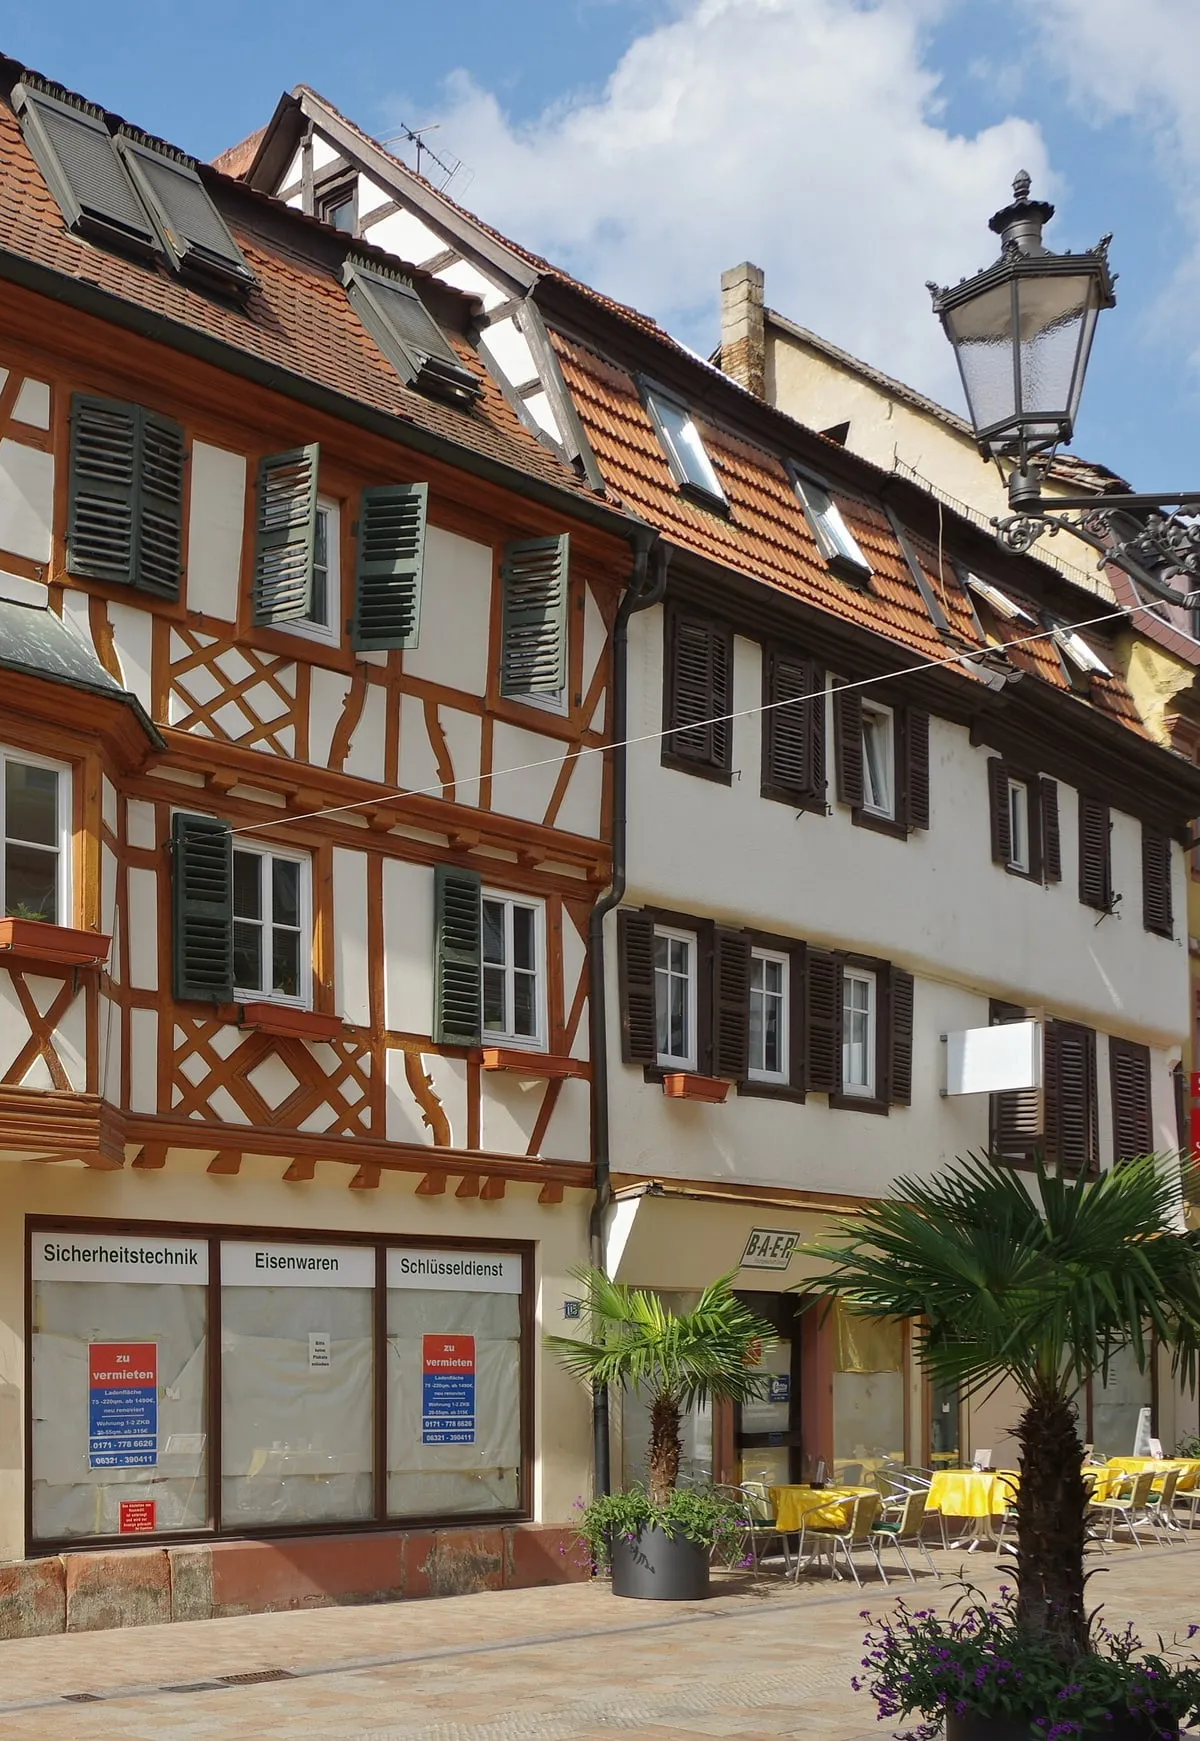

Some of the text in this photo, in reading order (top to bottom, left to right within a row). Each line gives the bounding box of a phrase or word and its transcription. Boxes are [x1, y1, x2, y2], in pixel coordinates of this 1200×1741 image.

[43, 1243, 198, 1265] Sicherheitstechnik
[255, 1252, 339, 1271] Eisenwaren
[400, 1258, 503, 1277] Schlüsseldienst
[116, 1355, 130, 1363] zu
[426, 1358, 473, 1367] vermieten
[93, 1370, 153, 1380] vermieten
[124, 1455, 153, 1463] 390411
